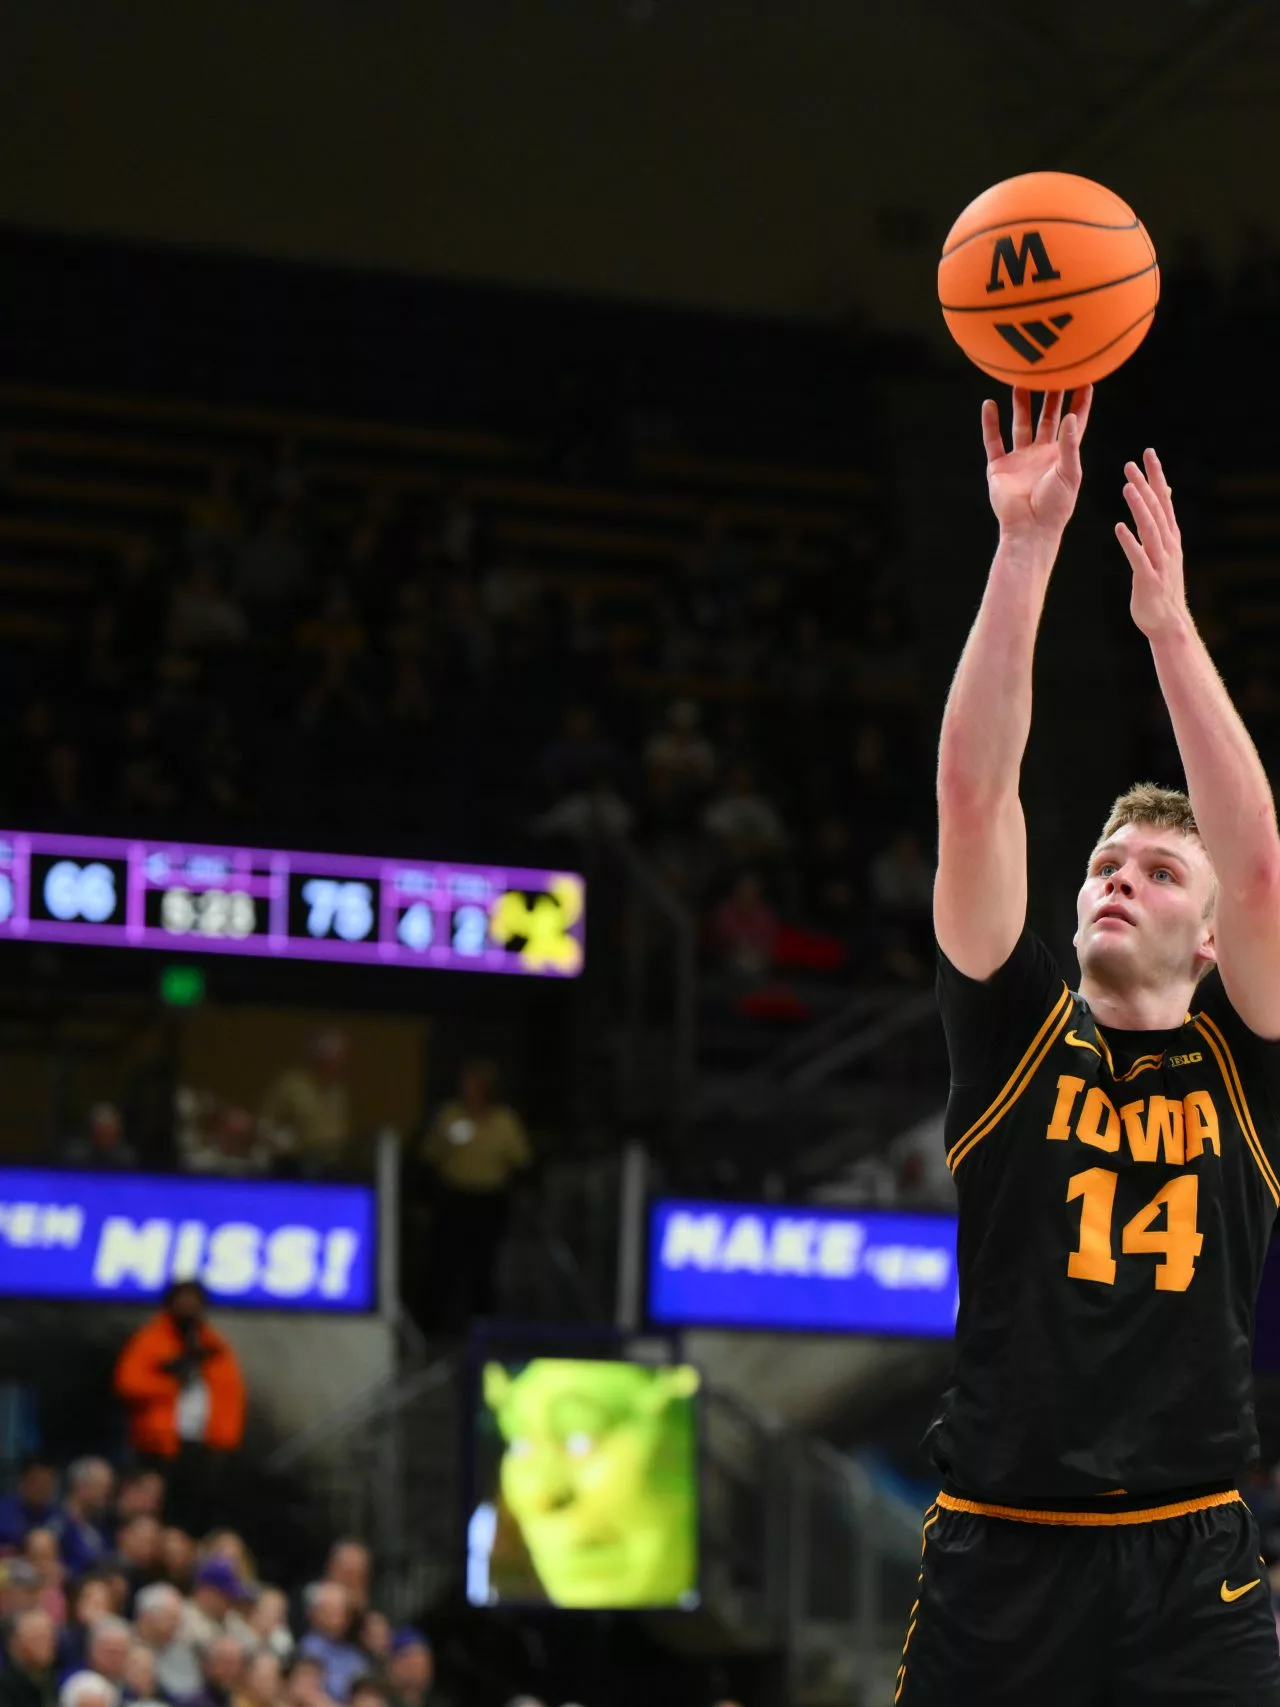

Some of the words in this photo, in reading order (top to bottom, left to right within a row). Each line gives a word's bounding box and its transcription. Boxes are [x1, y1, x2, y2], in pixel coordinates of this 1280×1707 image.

[1046, 1074, 1221, 1165] IOWA
[93, 1215, 360, 1299] MISS!
[661, 1210, 865, 1279] MAKE
[1066, 1166, 1204, 1292] 14
